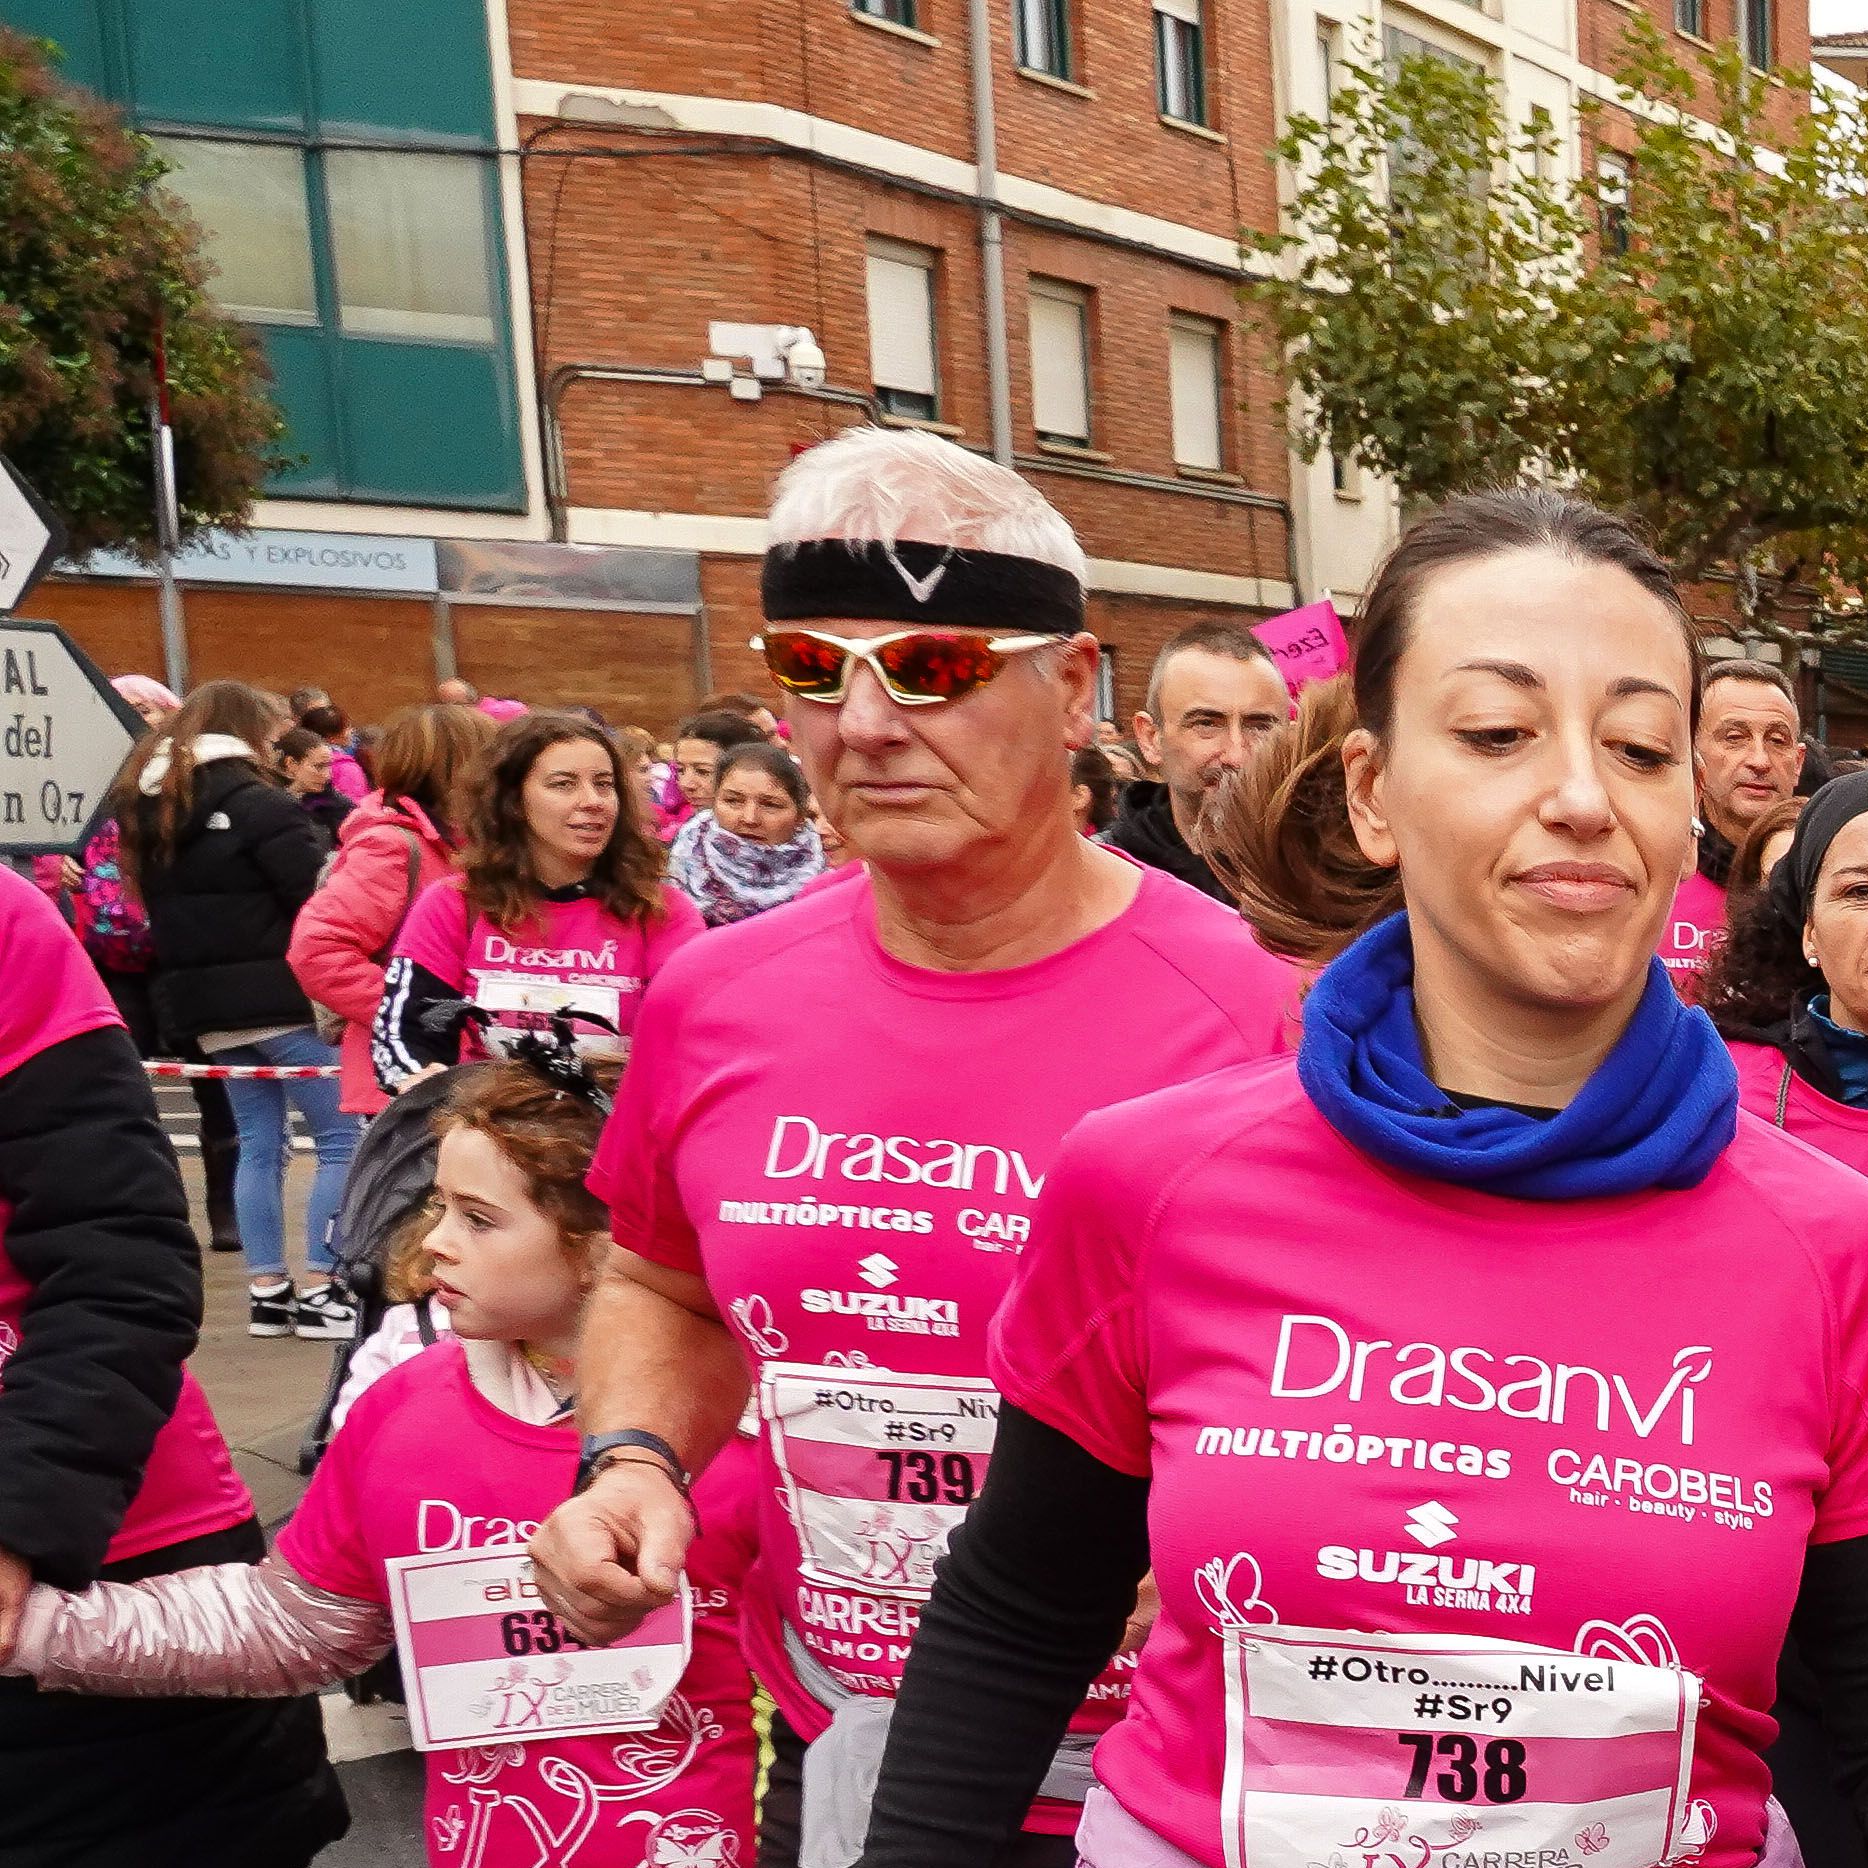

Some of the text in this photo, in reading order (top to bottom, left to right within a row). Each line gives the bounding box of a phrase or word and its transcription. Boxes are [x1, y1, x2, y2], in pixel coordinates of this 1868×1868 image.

[266, 544, 408, 571] EXPLOSIVOS
[5, 712, 53, 759] del
[764, 1114, 1047, 1200] Drasanv
[800, 1288, 960, 1325] SUZUKI
[885, 1420, 957, 1443] #Sr9
[876, 1450, 976, 1505] 739
[1547, 1447, 1774, 1518] CAROBELS
[1569, 1486, 1754, 1532] hair beauty style
[1316, 1545, 1537, 1595] SUZUKI
[796, 1586, 922, 1637] CARRER
[1406, 1584, 1430, 1607] LA
[1432, 1586, 1491, 1613] SERNA
[1413, 1693, 1514, 1725] #Sr9
[1398, 1732, 1528, 1804] 738
